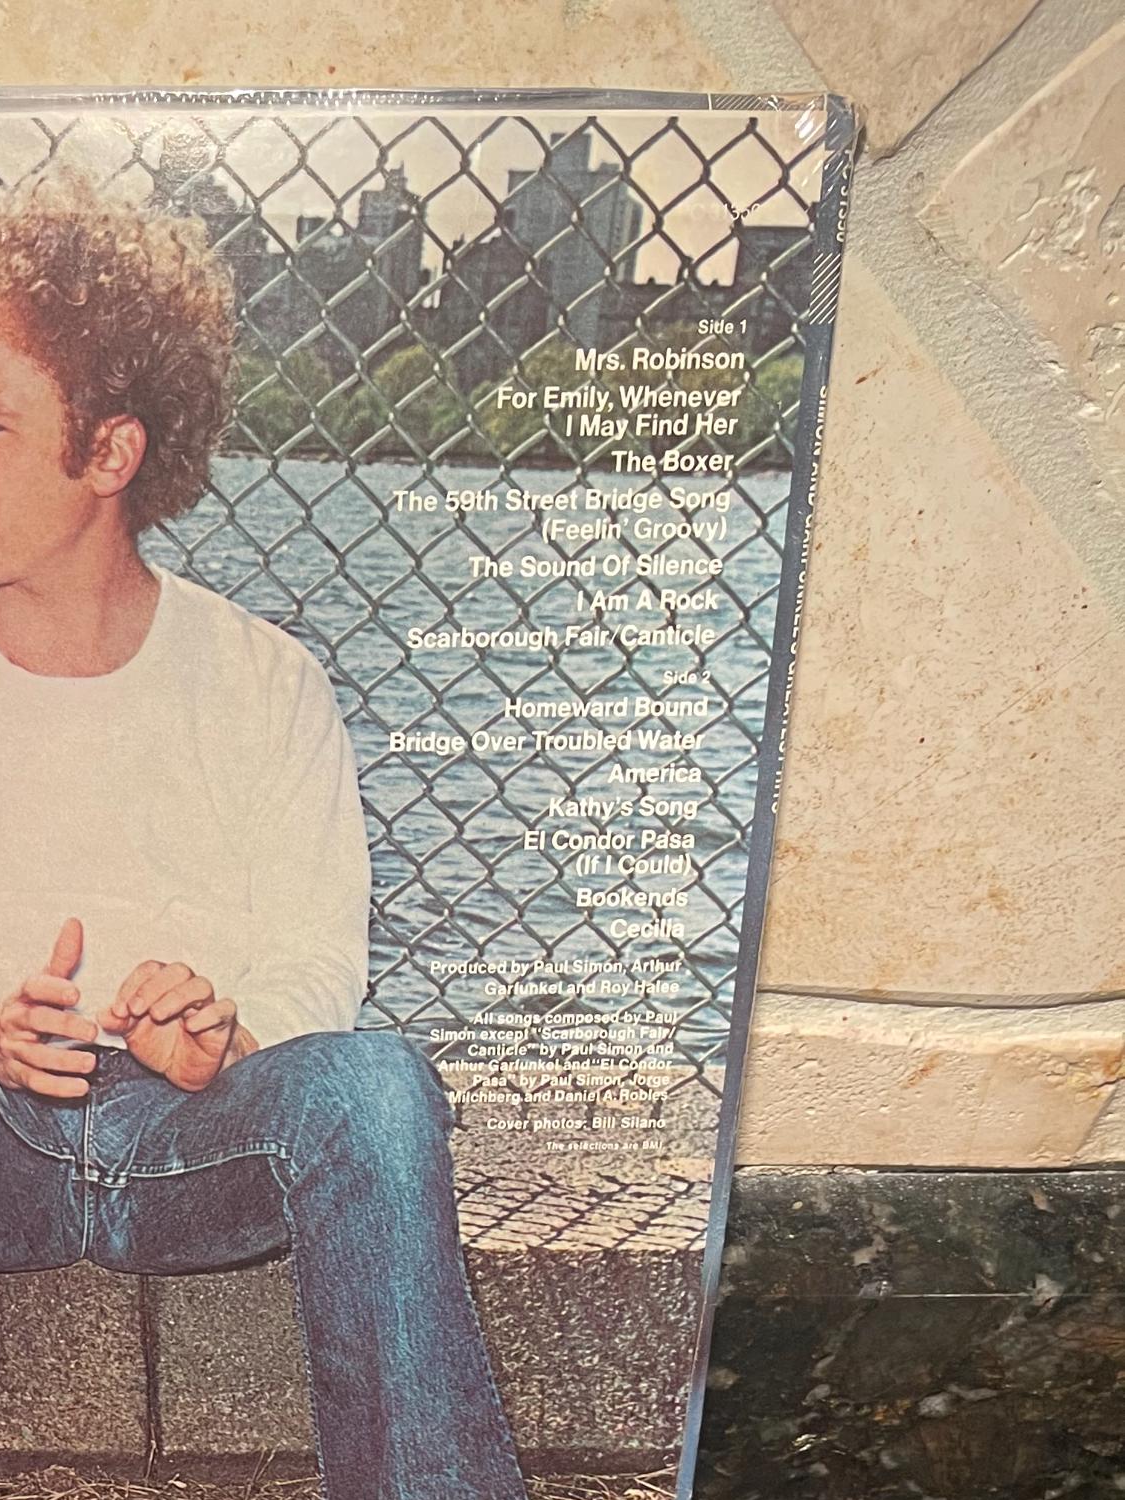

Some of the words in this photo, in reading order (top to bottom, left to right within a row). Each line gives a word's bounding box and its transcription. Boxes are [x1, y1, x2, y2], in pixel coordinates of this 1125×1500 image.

[698, 320, 733, 334] Side
[742, 320, 747, 333] 1
[575, 349, 625, 371] Mrs.
[632, 348, 744, 370] Robinson
[497, 388, 536, 408] For
[544, 387, 614, 412] Emily,
[620, 386, 741, 407] Whenever
[565, 416, 572, 436] I
[579, 415, 629, 440] May
[635, 415, 688, 435] Find
[695, 415, 737, 434] Her
[611, 451, 656, 472] The
[663, 451, 733, 471] Boxer
[394, 491, 438, 511] The
[445, 490, 497, 511] 59th
[506, 490, 578, 510] Street
[585, 488, 662, 515] Bridge
[669, 488, 730, 511] Song
[542, 519, 628, 542] (Feelin'
[634, 517, 727, 541] Groovy)
[469, 557, 513, 577] The
[520, 556, 595, 576] Sound
[603, 556, 630, 576] Of
[637, 555, 723, 575] Silence
[578, 591, 583, 610] I
[590, 590, 628, 609] Am
[637, 590, 651, 609] A
[660, 590, 718, 609] Rock
[407, 627, 558, 652] Scarborough
[565, 625, 715, 647] Fair/Canticle
[663, 671, 695, 685] Side
[702, 671, 710, 684] 2
[505, 698, 627, 717] Homeward
[634, 697, 708, 716] Bound
[389, 733, 465, 755] Bridge
[472, 733, 526, 751] Over
[532, 731, 631, 750] Troubled
[638, 730, 705, 749] Water
[607, 765, 701, 783] America
[549, 798, 633, 821] Kathy's
[638, 797, 698, 819] Song
[523, 832, 545, 850] El
[552, 831, 634, 849] Condor
[641, 830, 695, 848] Pasa
[576, 855, 600, 876] (If
[618, 854, 691, 875] Could)
[576, 888, 688, 907] Bookends
[610, 920, 684, 938] Cecilia
[430, 961, 507, 974] Produced
[511, 961, 529, 976] by
[533, 961, 568, 973] Paul
[573, 960, 626, 977] Simon,
[631, 959, 681, 972] Arthur
[485, 982, 562, 995] Garfunkel
[567, 981, 595, 994] and
[601, 981, 630, 996] Roy
[635, 981, 679, 993] Halee
[473, 1013, 493, 1024] All
[497, 1014, 541, 1026] songs
[546, 1011, 619, 1026] composed
[624, 1012, 641, 1026] by
[646, 1011, 676, 1024] Paul
[430, 1029, 475, 1040] Simon
[480, 1029, 528, 1042] except
[540, 1043, 557, 1058] by
[562, 1043, 593, 1055] Paul
[597, 1043, 642, 1055] Simon
[647, 1042, 673, 1054] and
[438, 1060, 484, 1071] Arthur
[489, 1060, 559, 1071] Garfunkel
[619, 1059, 672, 1070] Condor
[520, 1074, 537, 1088] by
[541, 1075, 572, 1086] Paul
[630, 1074, 669, 1087] Jorge
[449, 1092, 521, 1105] Milchberg
[525, 1091, 551, 1102] and
[555, 1090, 600, 1102] Daniel
[619, 1089, 668, 1100] Robles
[487, 1119, 529, 1129] Cover
[592, 1118, 615, 1128] Bill
[621, 1117, 666, 1128] Silano
